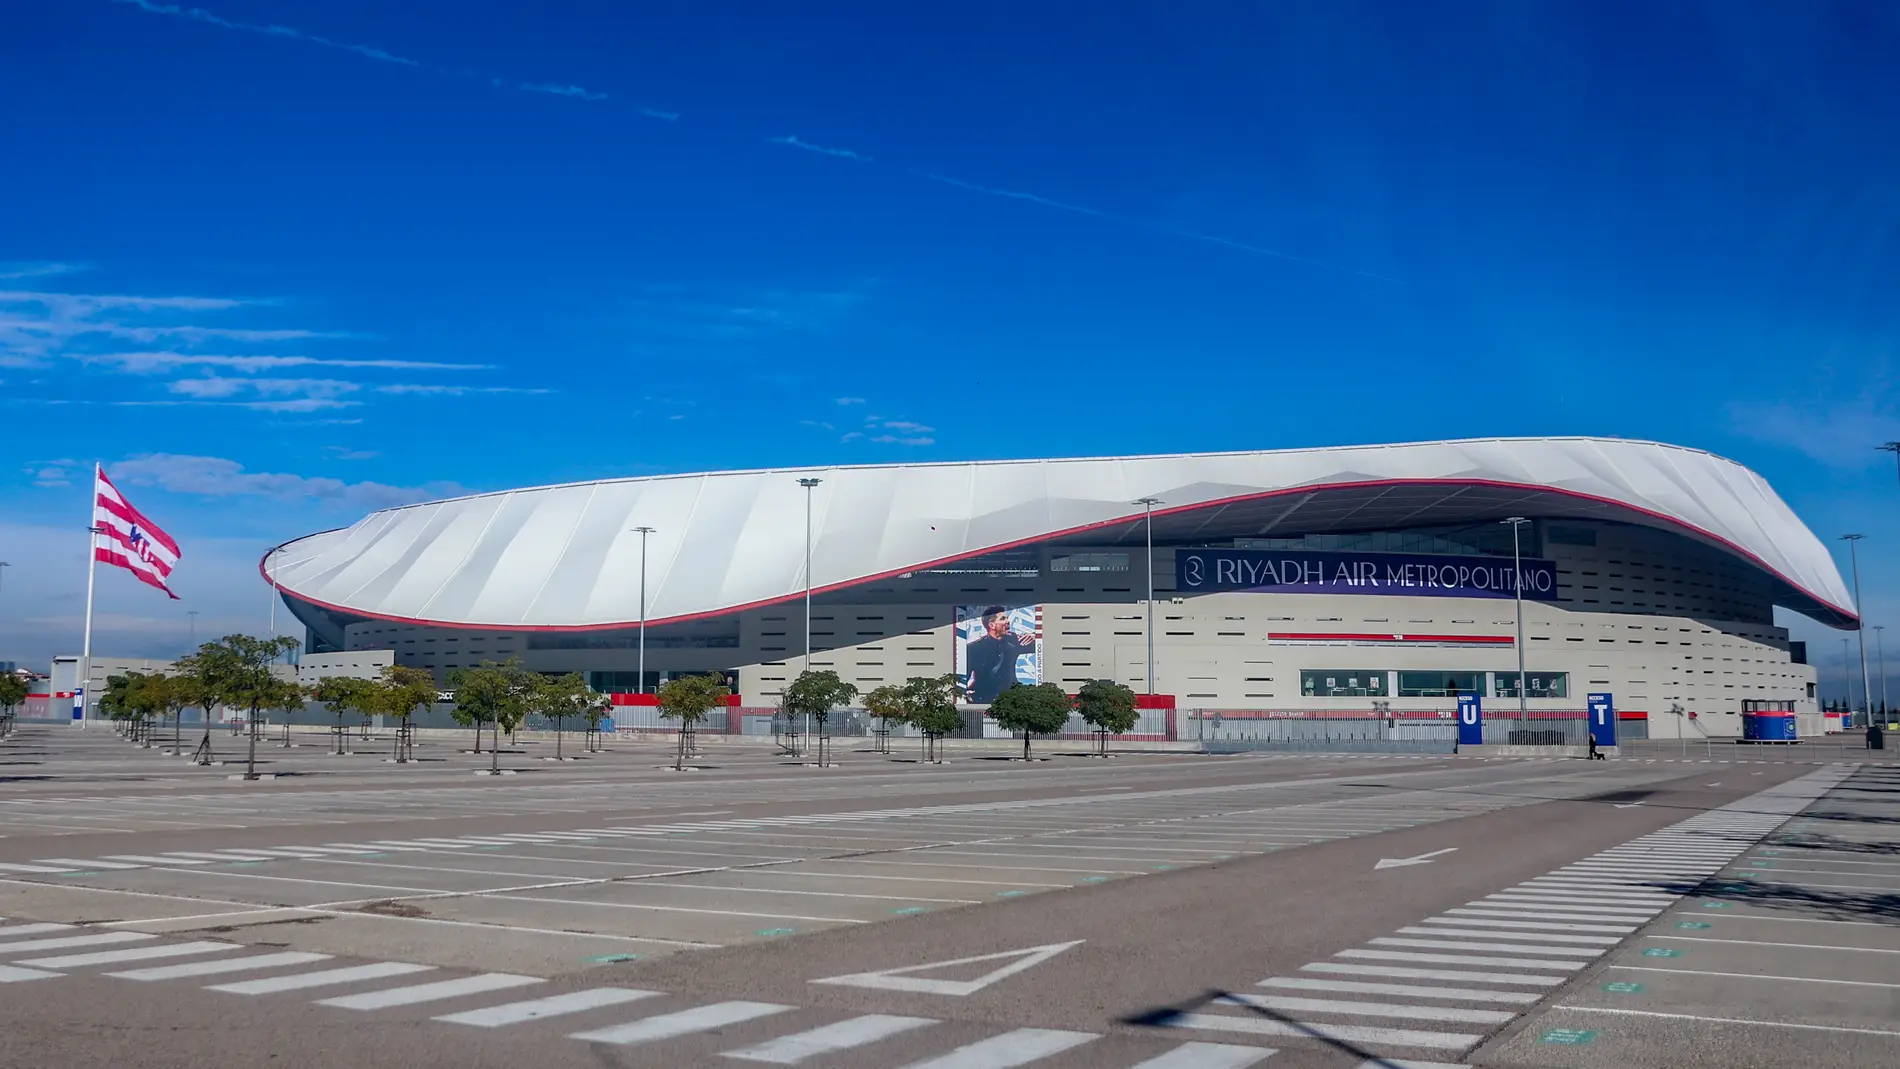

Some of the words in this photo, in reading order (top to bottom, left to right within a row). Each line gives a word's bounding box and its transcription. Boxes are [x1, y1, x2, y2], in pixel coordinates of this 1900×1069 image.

[1217, 558, 1324, 585] RIYADH
[1332, 561, 1379, 587] AIR
[1386, 563, 1552, 592] METROPOLITANO
[1462, 704, 1477, 724] U
[1594, 704, 1608, 725] T
